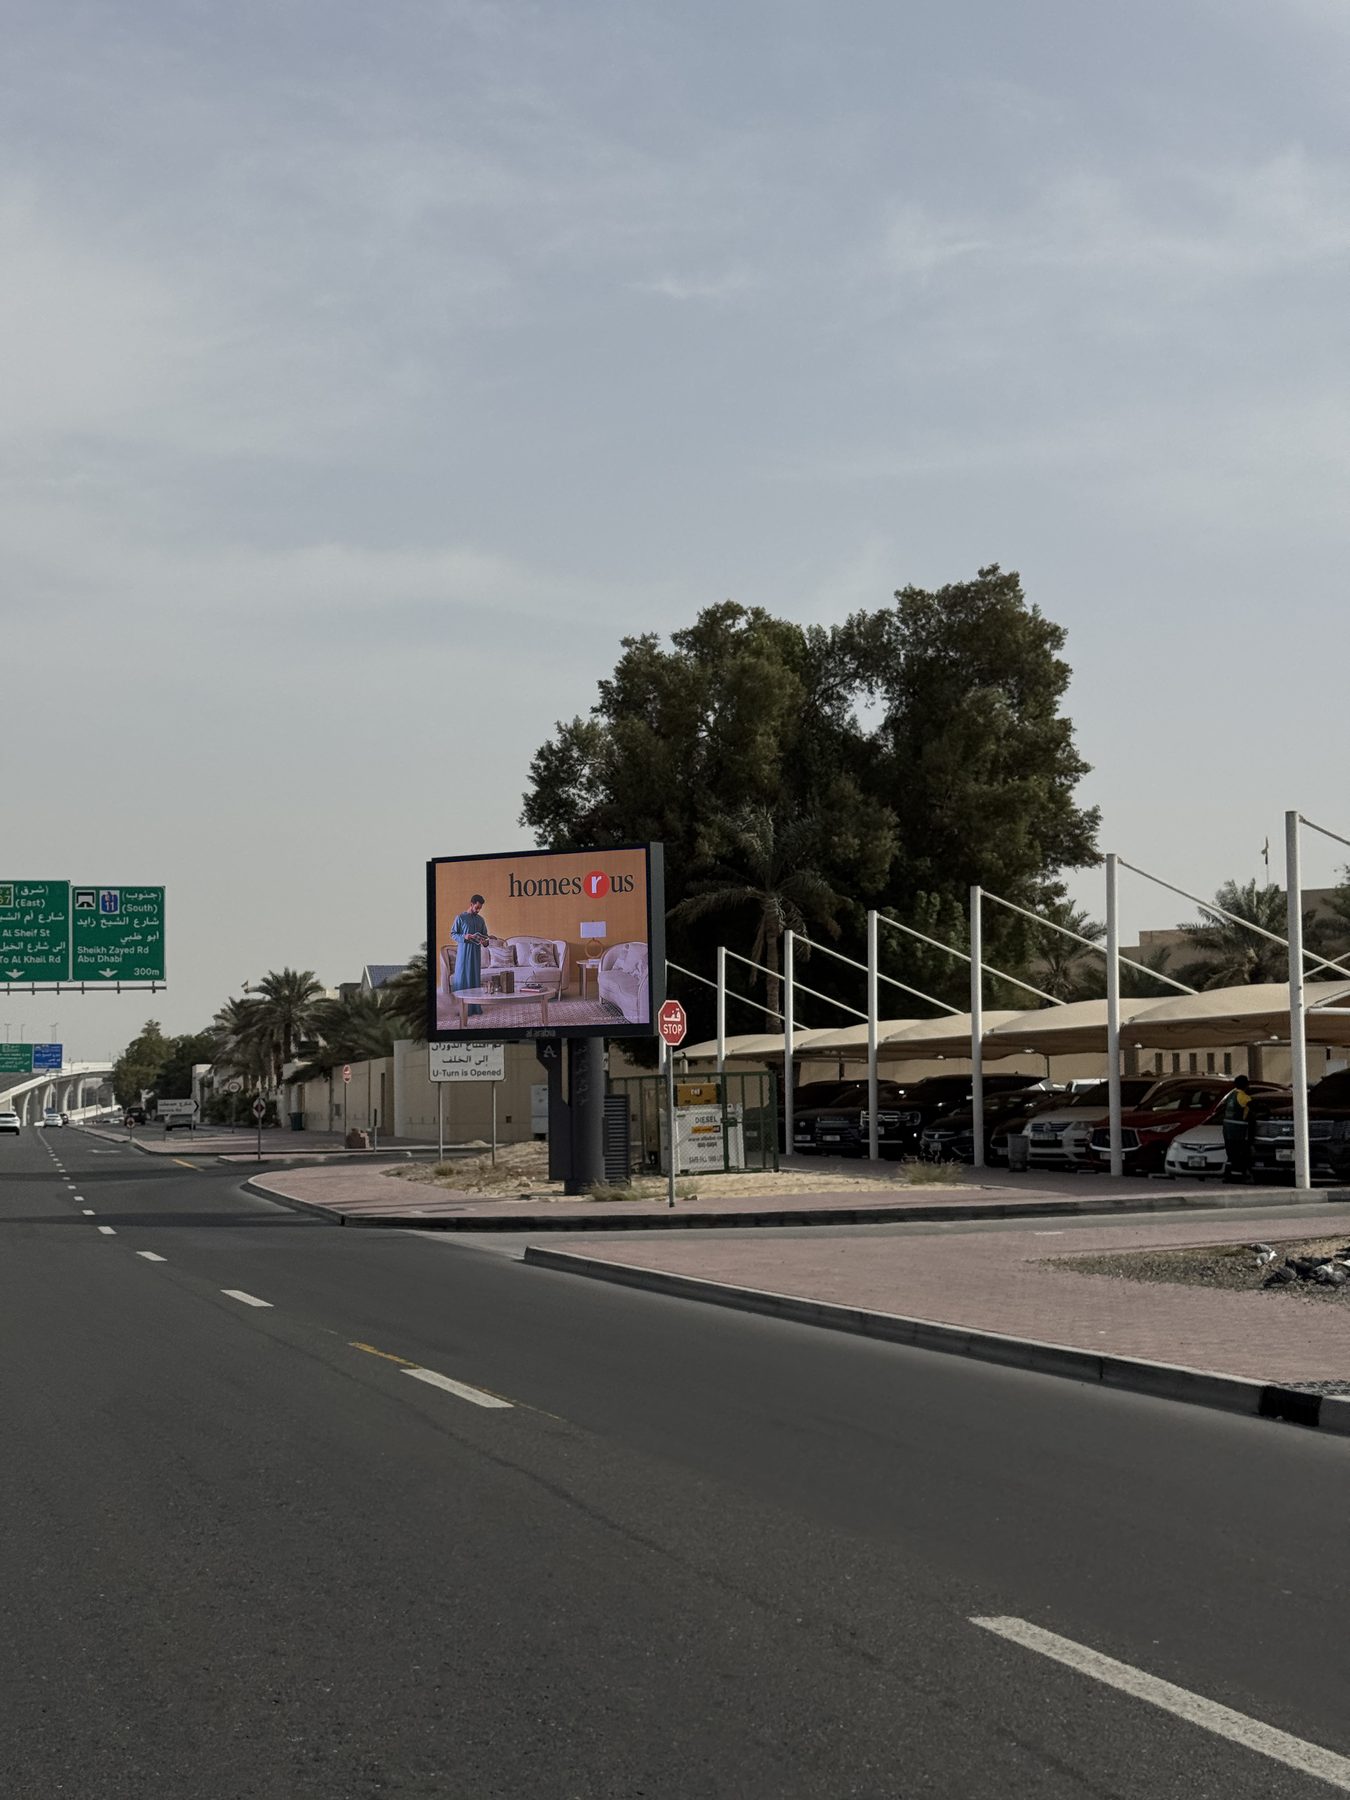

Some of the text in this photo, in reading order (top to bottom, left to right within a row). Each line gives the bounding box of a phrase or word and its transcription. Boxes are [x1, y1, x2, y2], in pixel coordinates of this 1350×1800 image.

[508, 872, 582, 897] homes
[610, 874, 634, 893] us
[15, 898, 45, 909] (East)
[122, 904, 157, 914] (South)
[38, 912, 65, 923] شارع
[77, 917, 160, 928] شارع الشيخ زايد
[40, 929, 50, 937] St
[27, 942, 49, 953] شارع
[77, 946, 149, 956] Sheikh Zayed Rd
[24, 955, 46, 964] Khail
[49, 955, 61, 964] Rd
[77, 954, 123, 963] Abu Dhabi
[134, 968, 160, 976] 300m
[663, 1008, 681, 1021] قف
[663, 1024, 683, 1035] STOP
[442, 1055, 472, 1064] الخلف
[432, 1068, 502, 1078] U-Turn is Opened
[694, 1116, 718, 1124] DIESEL
